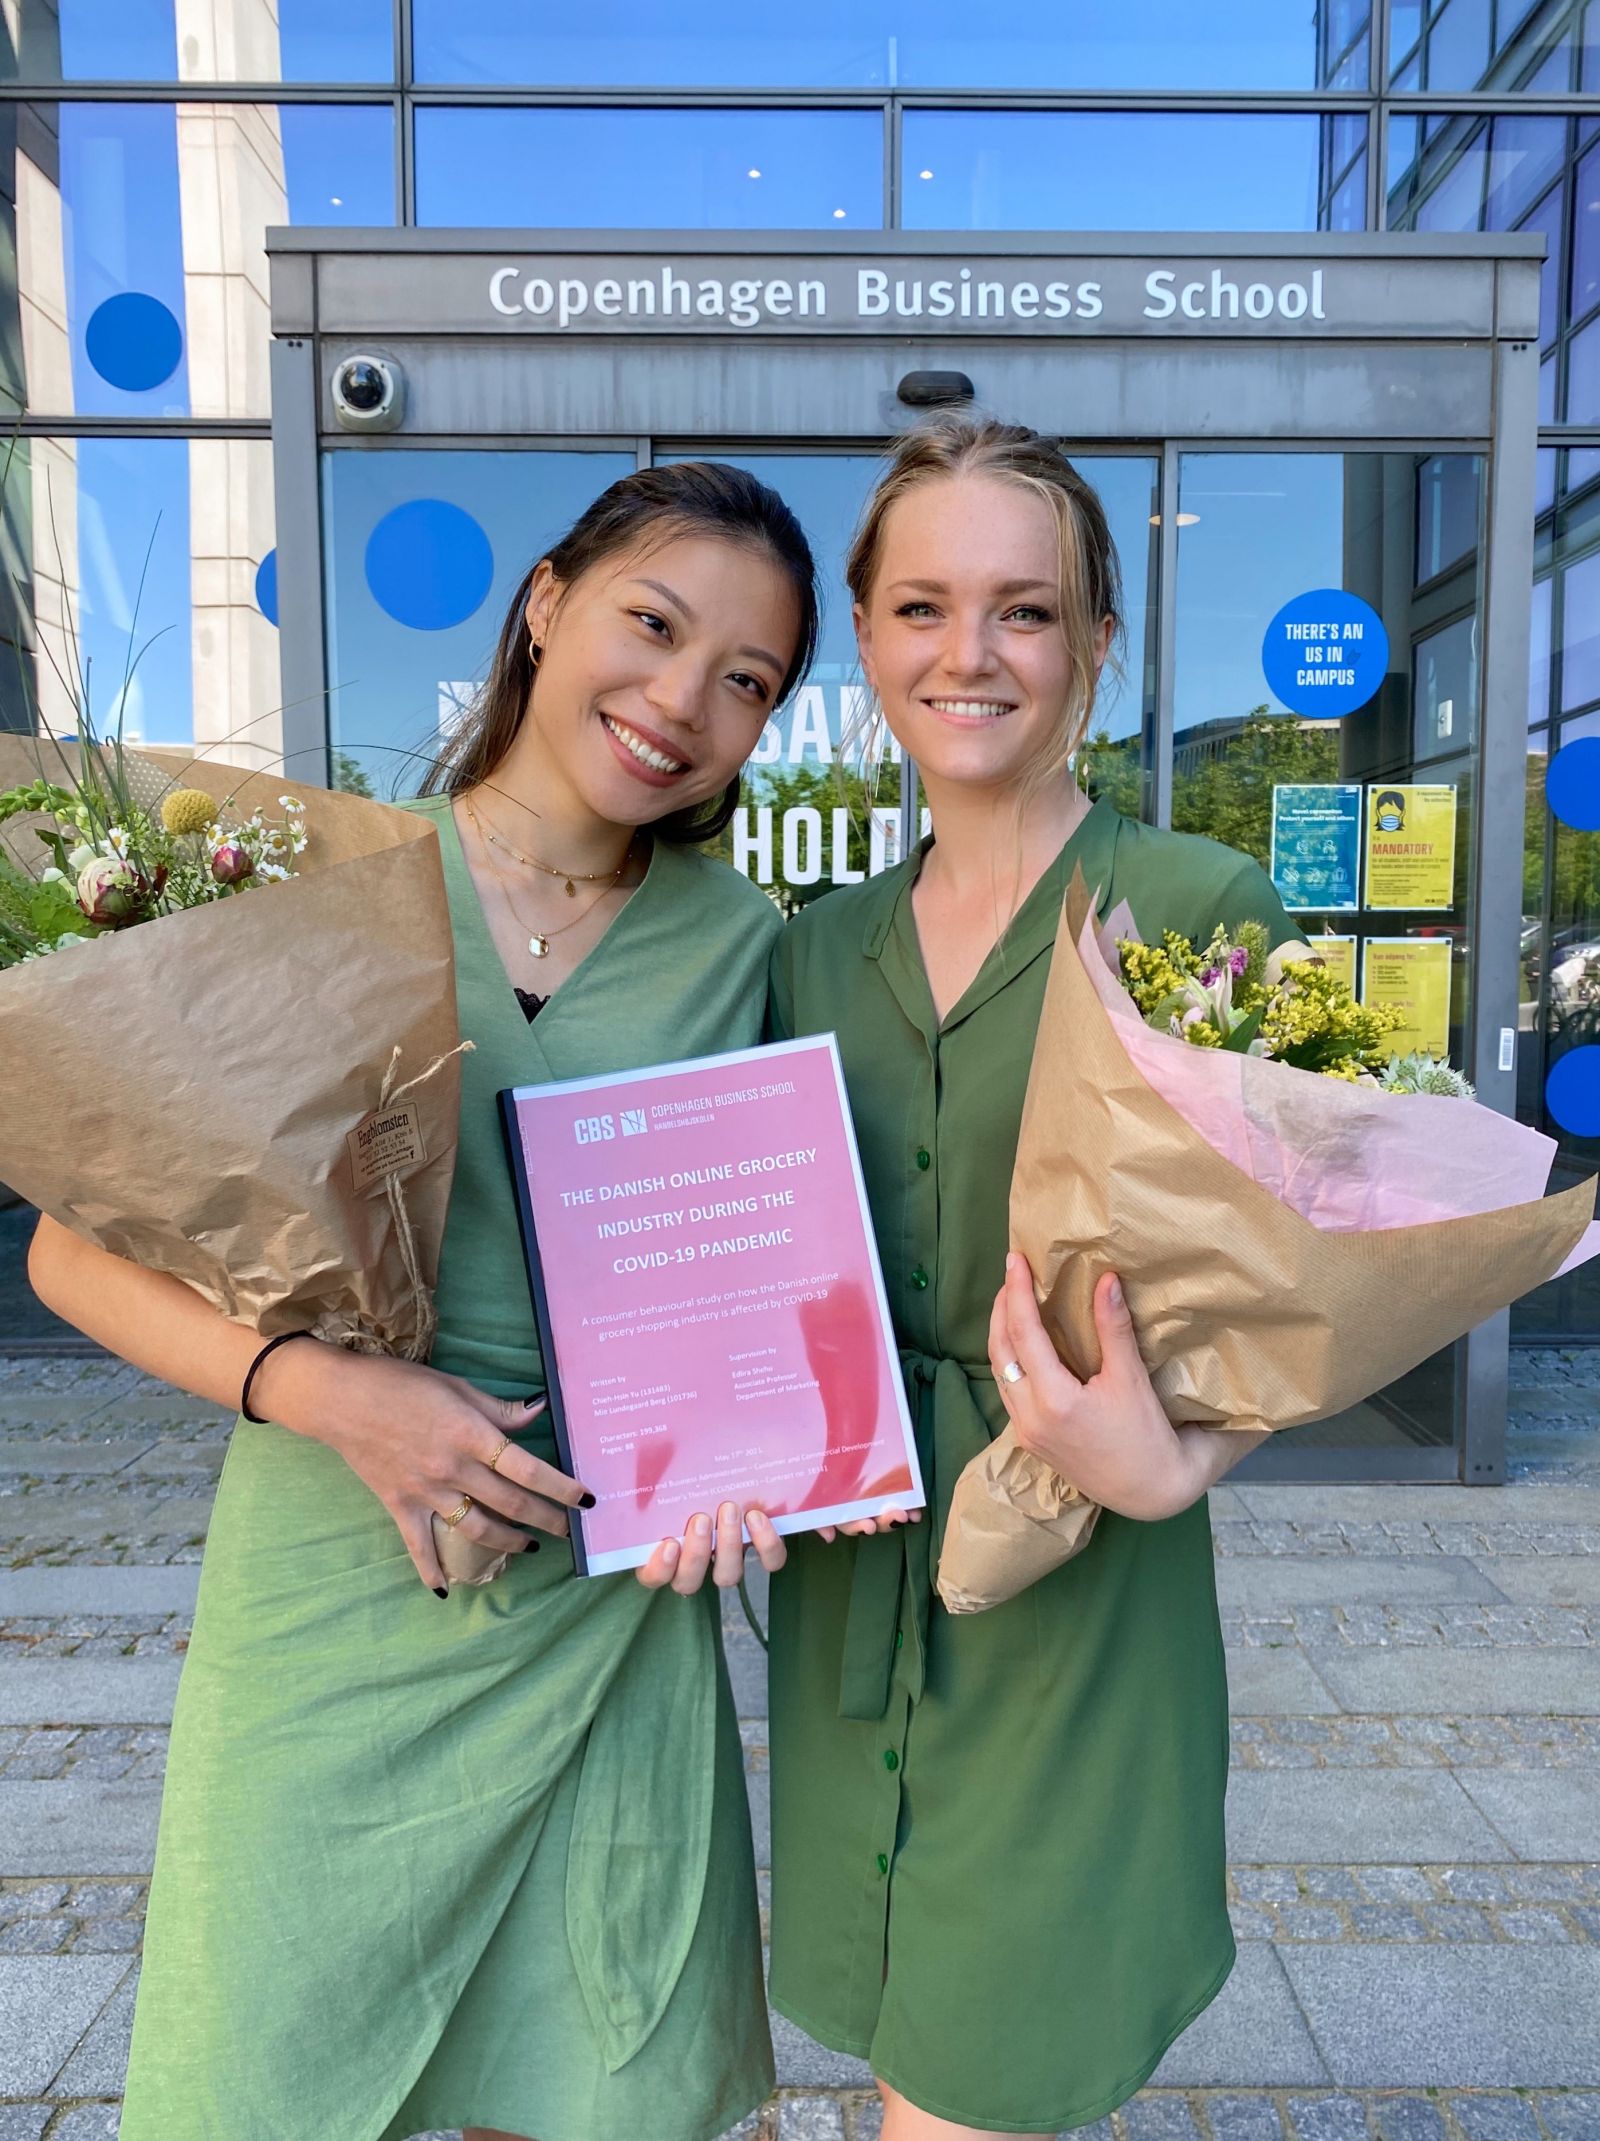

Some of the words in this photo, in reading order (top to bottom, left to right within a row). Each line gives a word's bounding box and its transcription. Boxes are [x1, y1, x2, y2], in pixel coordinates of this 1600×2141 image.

[488, 266, 826, 328] Copenhagen
[857, 267, 1103, 318] Business
[1143, 268, 1326, 319] School
[1285, 623, 1339, 640] THERE'S
[1343, 623, 1363, 640] AN
[1305, 646, 1323, 663] US
[1327, 646, 1343, 663] IN
[1297, 669, 1355, 686] CAMPUS
[1372, 843, 1434, 855] MANDATORY
[651, 1097, 713, 1118] COPENHAGEN
[715, 1088, 759, 1107] BUSINESS
[761, 1081, 796, 1098] SCHOOL
[357, 1113, 409, 1148] Engblomsten
[574, 1114, 615, 1145] CBS
[560, 1189, 595, 1207] THE
[599, 1176, 666, 1201] DANISH
[670, 1164, 734, 1188] ONLINE
[738, 1148, 817, 1176] GROCERY
[598, 1210, 684, 1239] INDUSTRY
[689, 1197, 758, 1223] DURING
[762, 1190, 795, 1209] THE
[613, 1246, 696, 1274] COVID-19
[701, 1228, 793, 1258] PANDEMIC
[582, 1318, 589, 1327] A
[591, 1310, 637, 1325] consumer
[640, 1298, 695, 1316] behavioural
[696, 1293, 720, 1306] study
[724, 1292, 736, 1301] on
[738, 1288, 757, 1298] how
[760, 1284, 775, 1293] the
[778, 1277, 808, 1290] Danish
[810, 1271, 839, 1284] online
[599, 1327, 635, 1342] grocery
[636, 1318, 680, 1332] shopping
[681, 1311, 720, 1325] industry
[730, 1300, 768, 1316] affected
[770, 1299, 782, 1309] by
[783, 1289, 828, 1306] COVID-19
